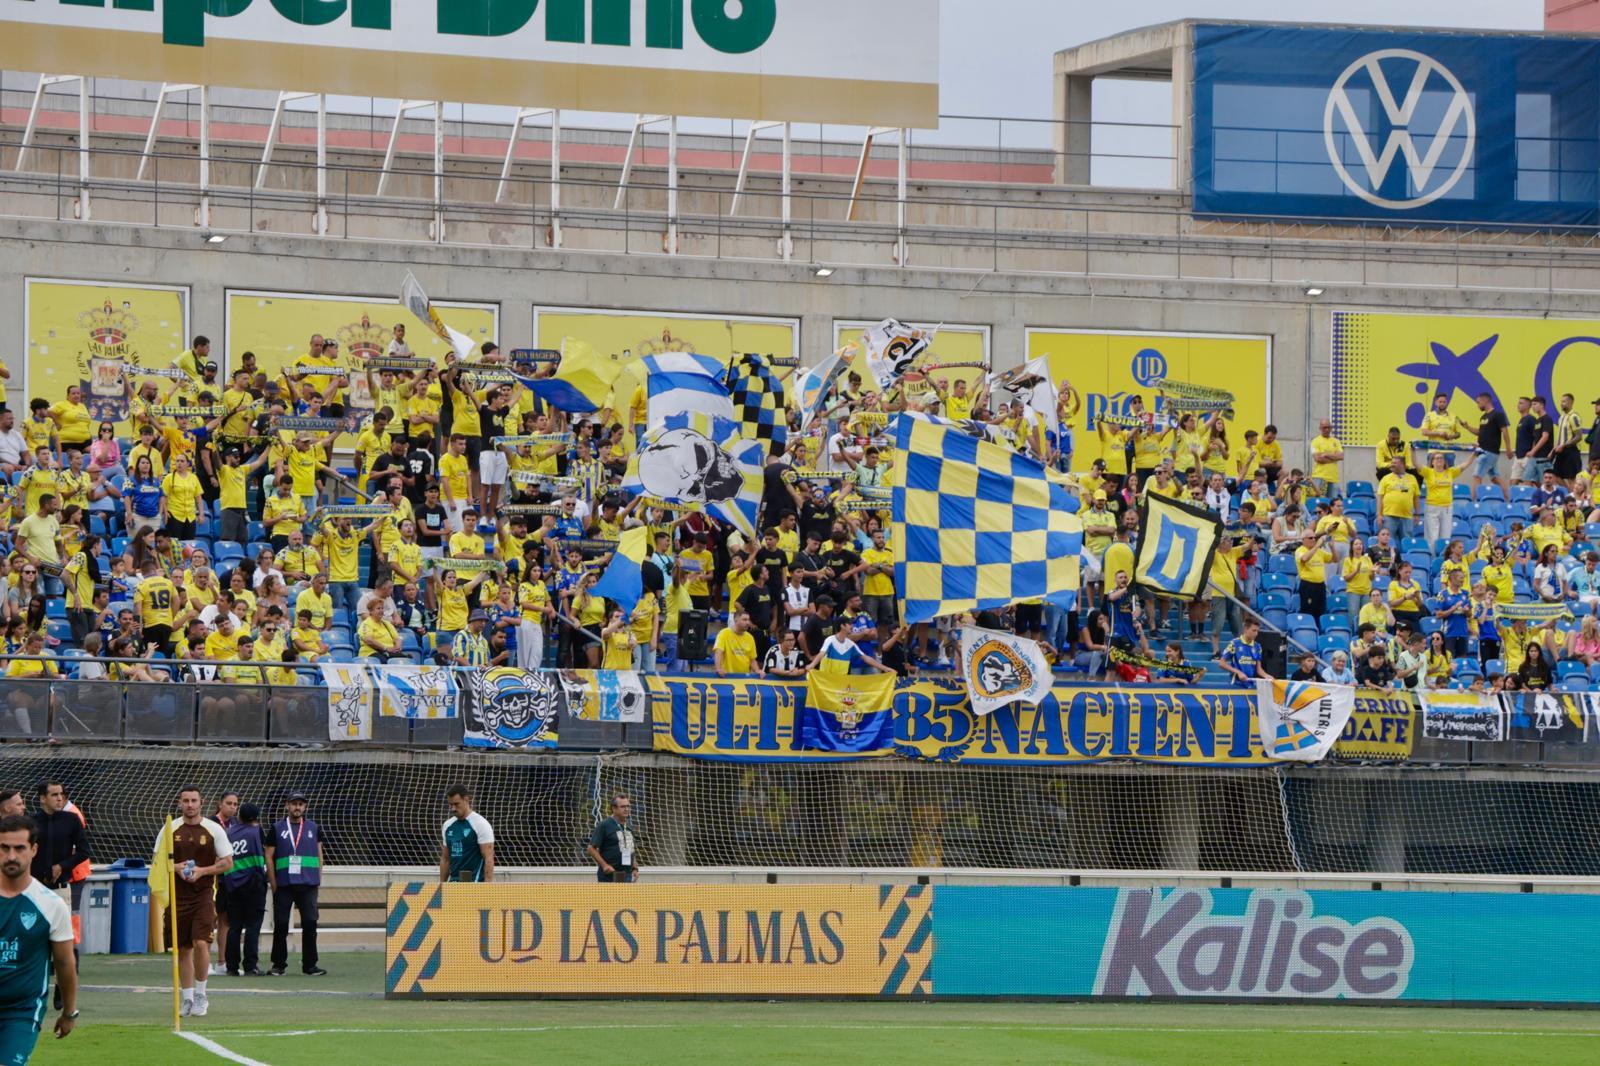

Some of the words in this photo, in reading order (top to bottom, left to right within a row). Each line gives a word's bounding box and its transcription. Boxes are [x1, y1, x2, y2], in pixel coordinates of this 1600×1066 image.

[408, 669, 448, 693] TIFO
[400, 695, 455, 709] STYLE
[478, 909, 543, 964] UD
[558, 909, 639, 965] LAS
[655, 909, 846, 965] PALMAS
[1100, 888, 1408, 996] Kalise
